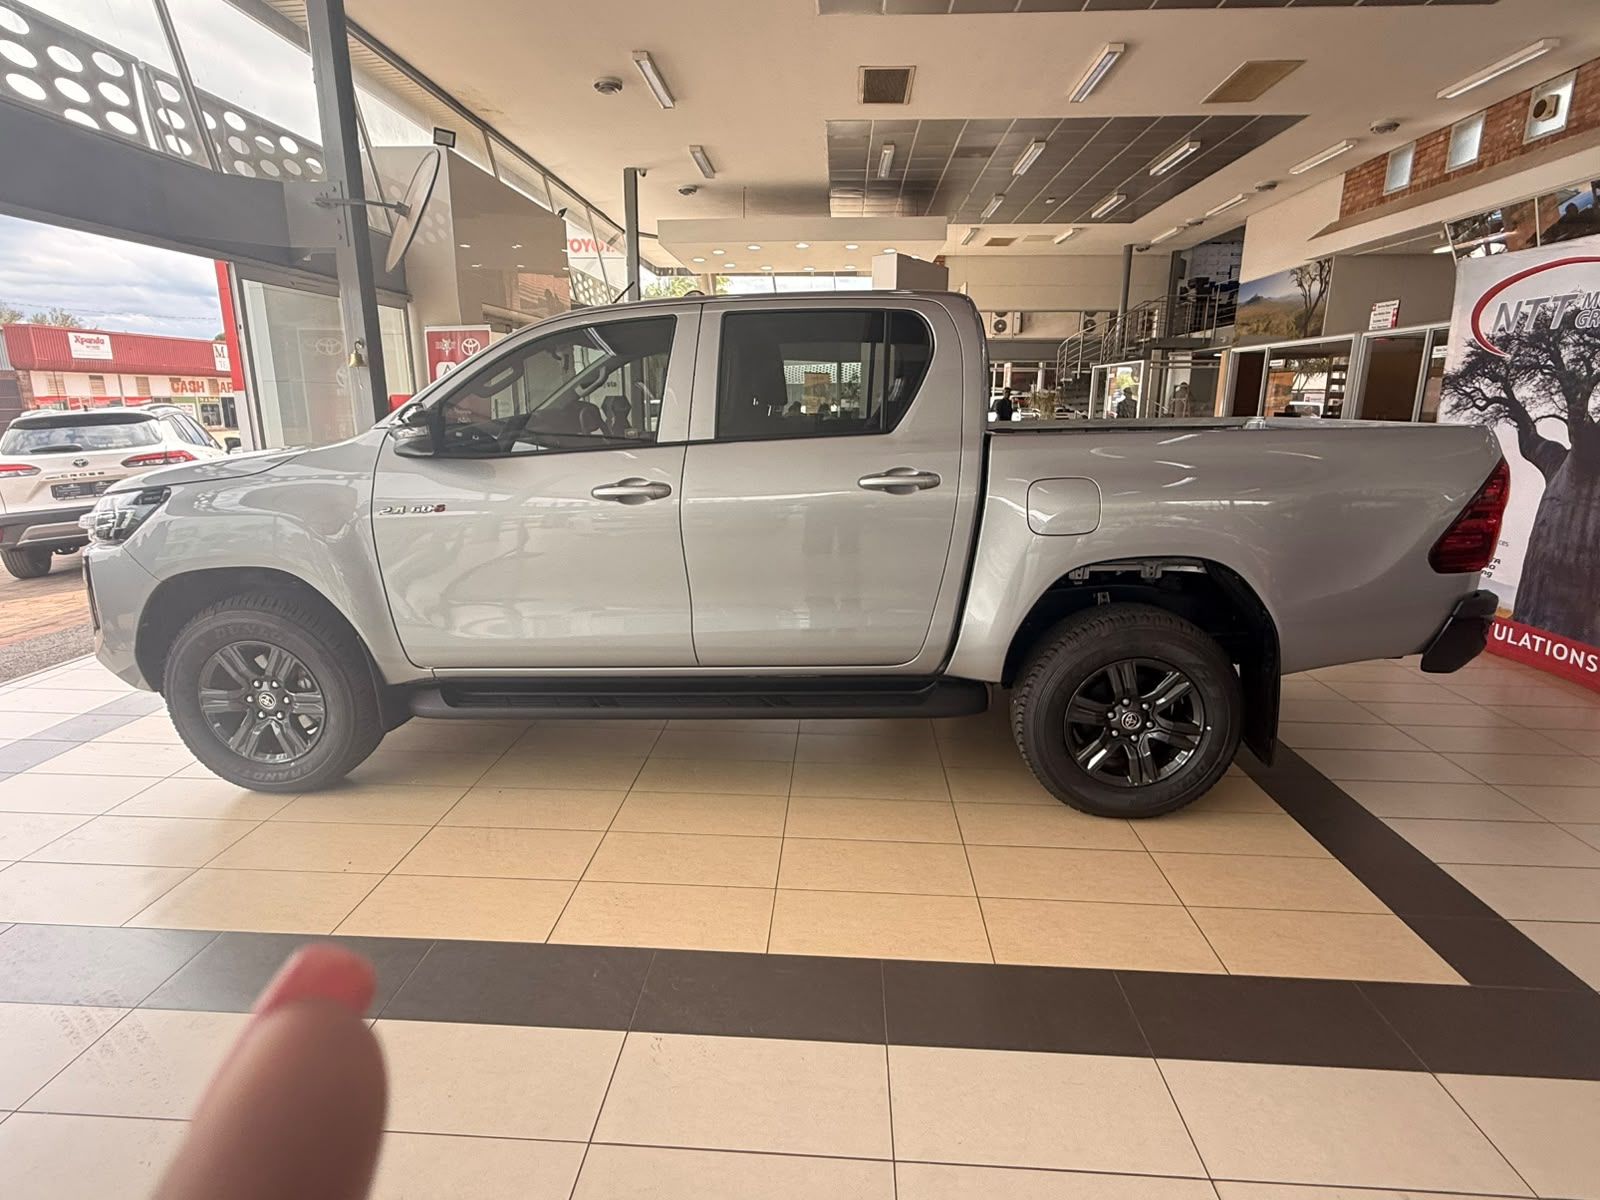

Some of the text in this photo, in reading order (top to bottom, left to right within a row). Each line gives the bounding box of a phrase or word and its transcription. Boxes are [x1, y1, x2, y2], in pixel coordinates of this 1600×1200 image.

[1582, 291, 1600, 310] M
[1491, 294, 1578, 333] NTT
[1575, 309, 1600, 328] GR
[74, 335, 105, 345] Xpanda
[170, 380, 205, 393] CASH
[1491, 622, 1598, 672] ULATIONS
